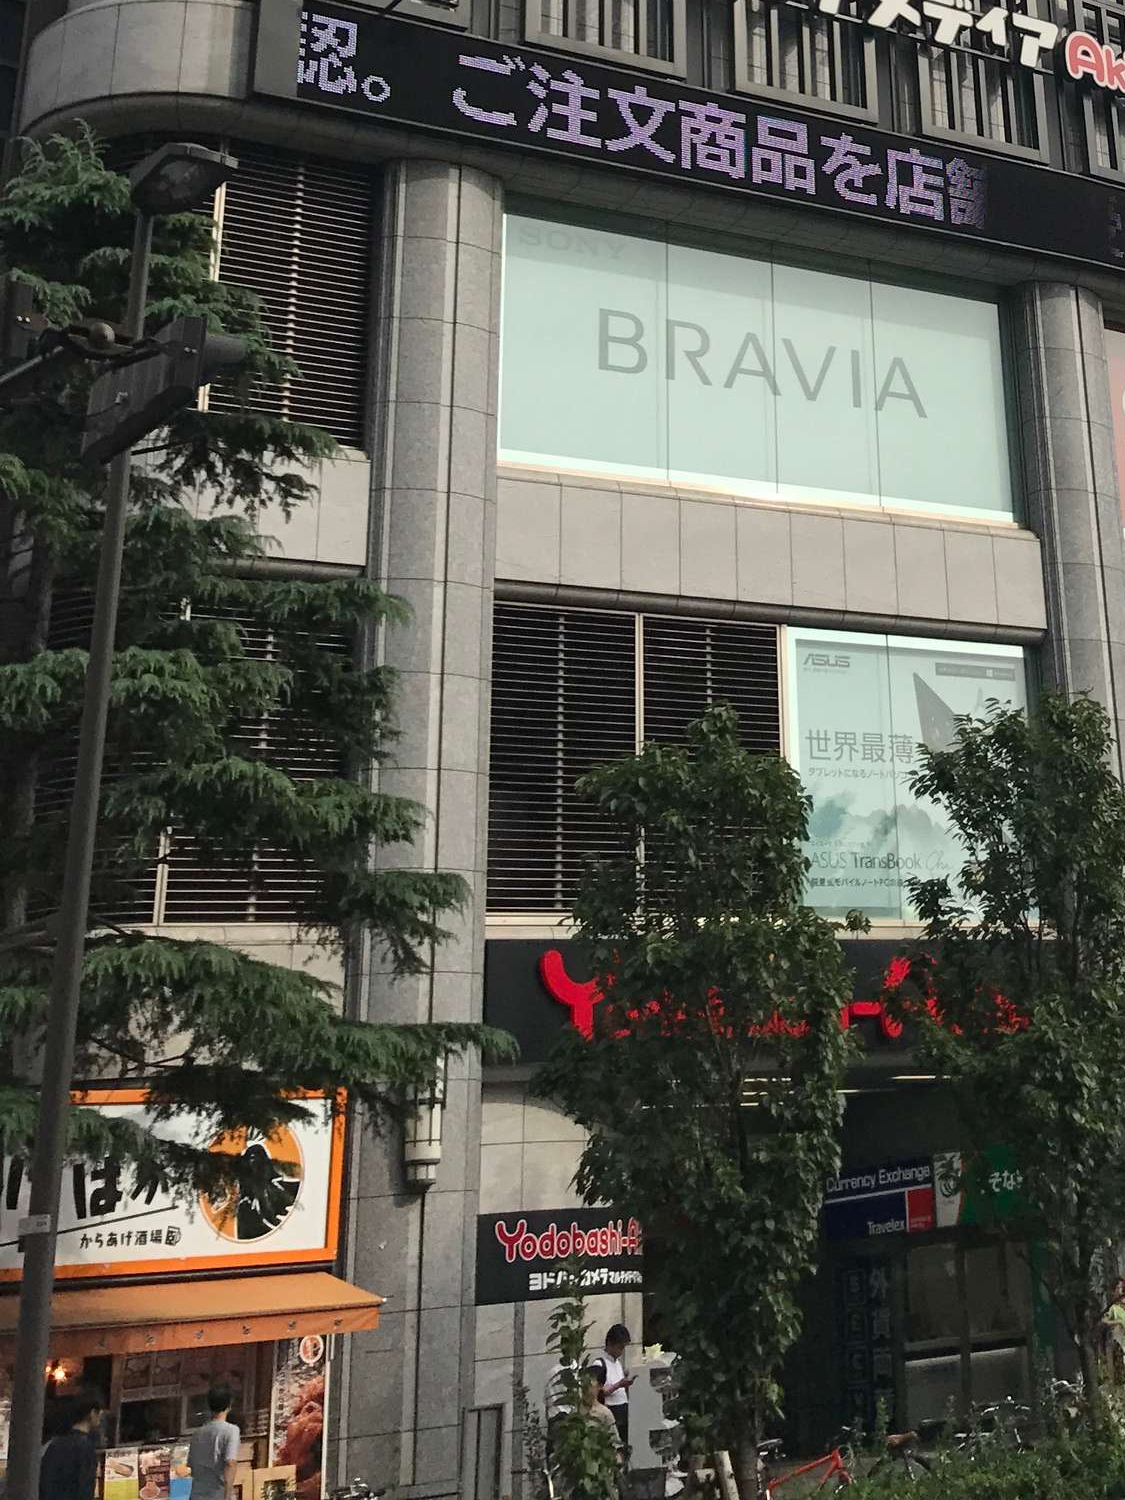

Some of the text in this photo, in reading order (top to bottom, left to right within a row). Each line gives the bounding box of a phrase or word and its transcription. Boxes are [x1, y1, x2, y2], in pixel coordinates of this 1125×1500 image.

[518, 226, 625, 260] SONY
[597, 308, 928, 419] BRAVIA
[803, 653, 851, 669] ASUS
[805, 728, 914, 764] 世界最薄
[811, 851, 847, 869] ASUS
[850, 851, 921, 869] TransBook
[826, 1164, 931, 1194] Currency Exchange
[867, 1218, 905, 1235] Travelex
